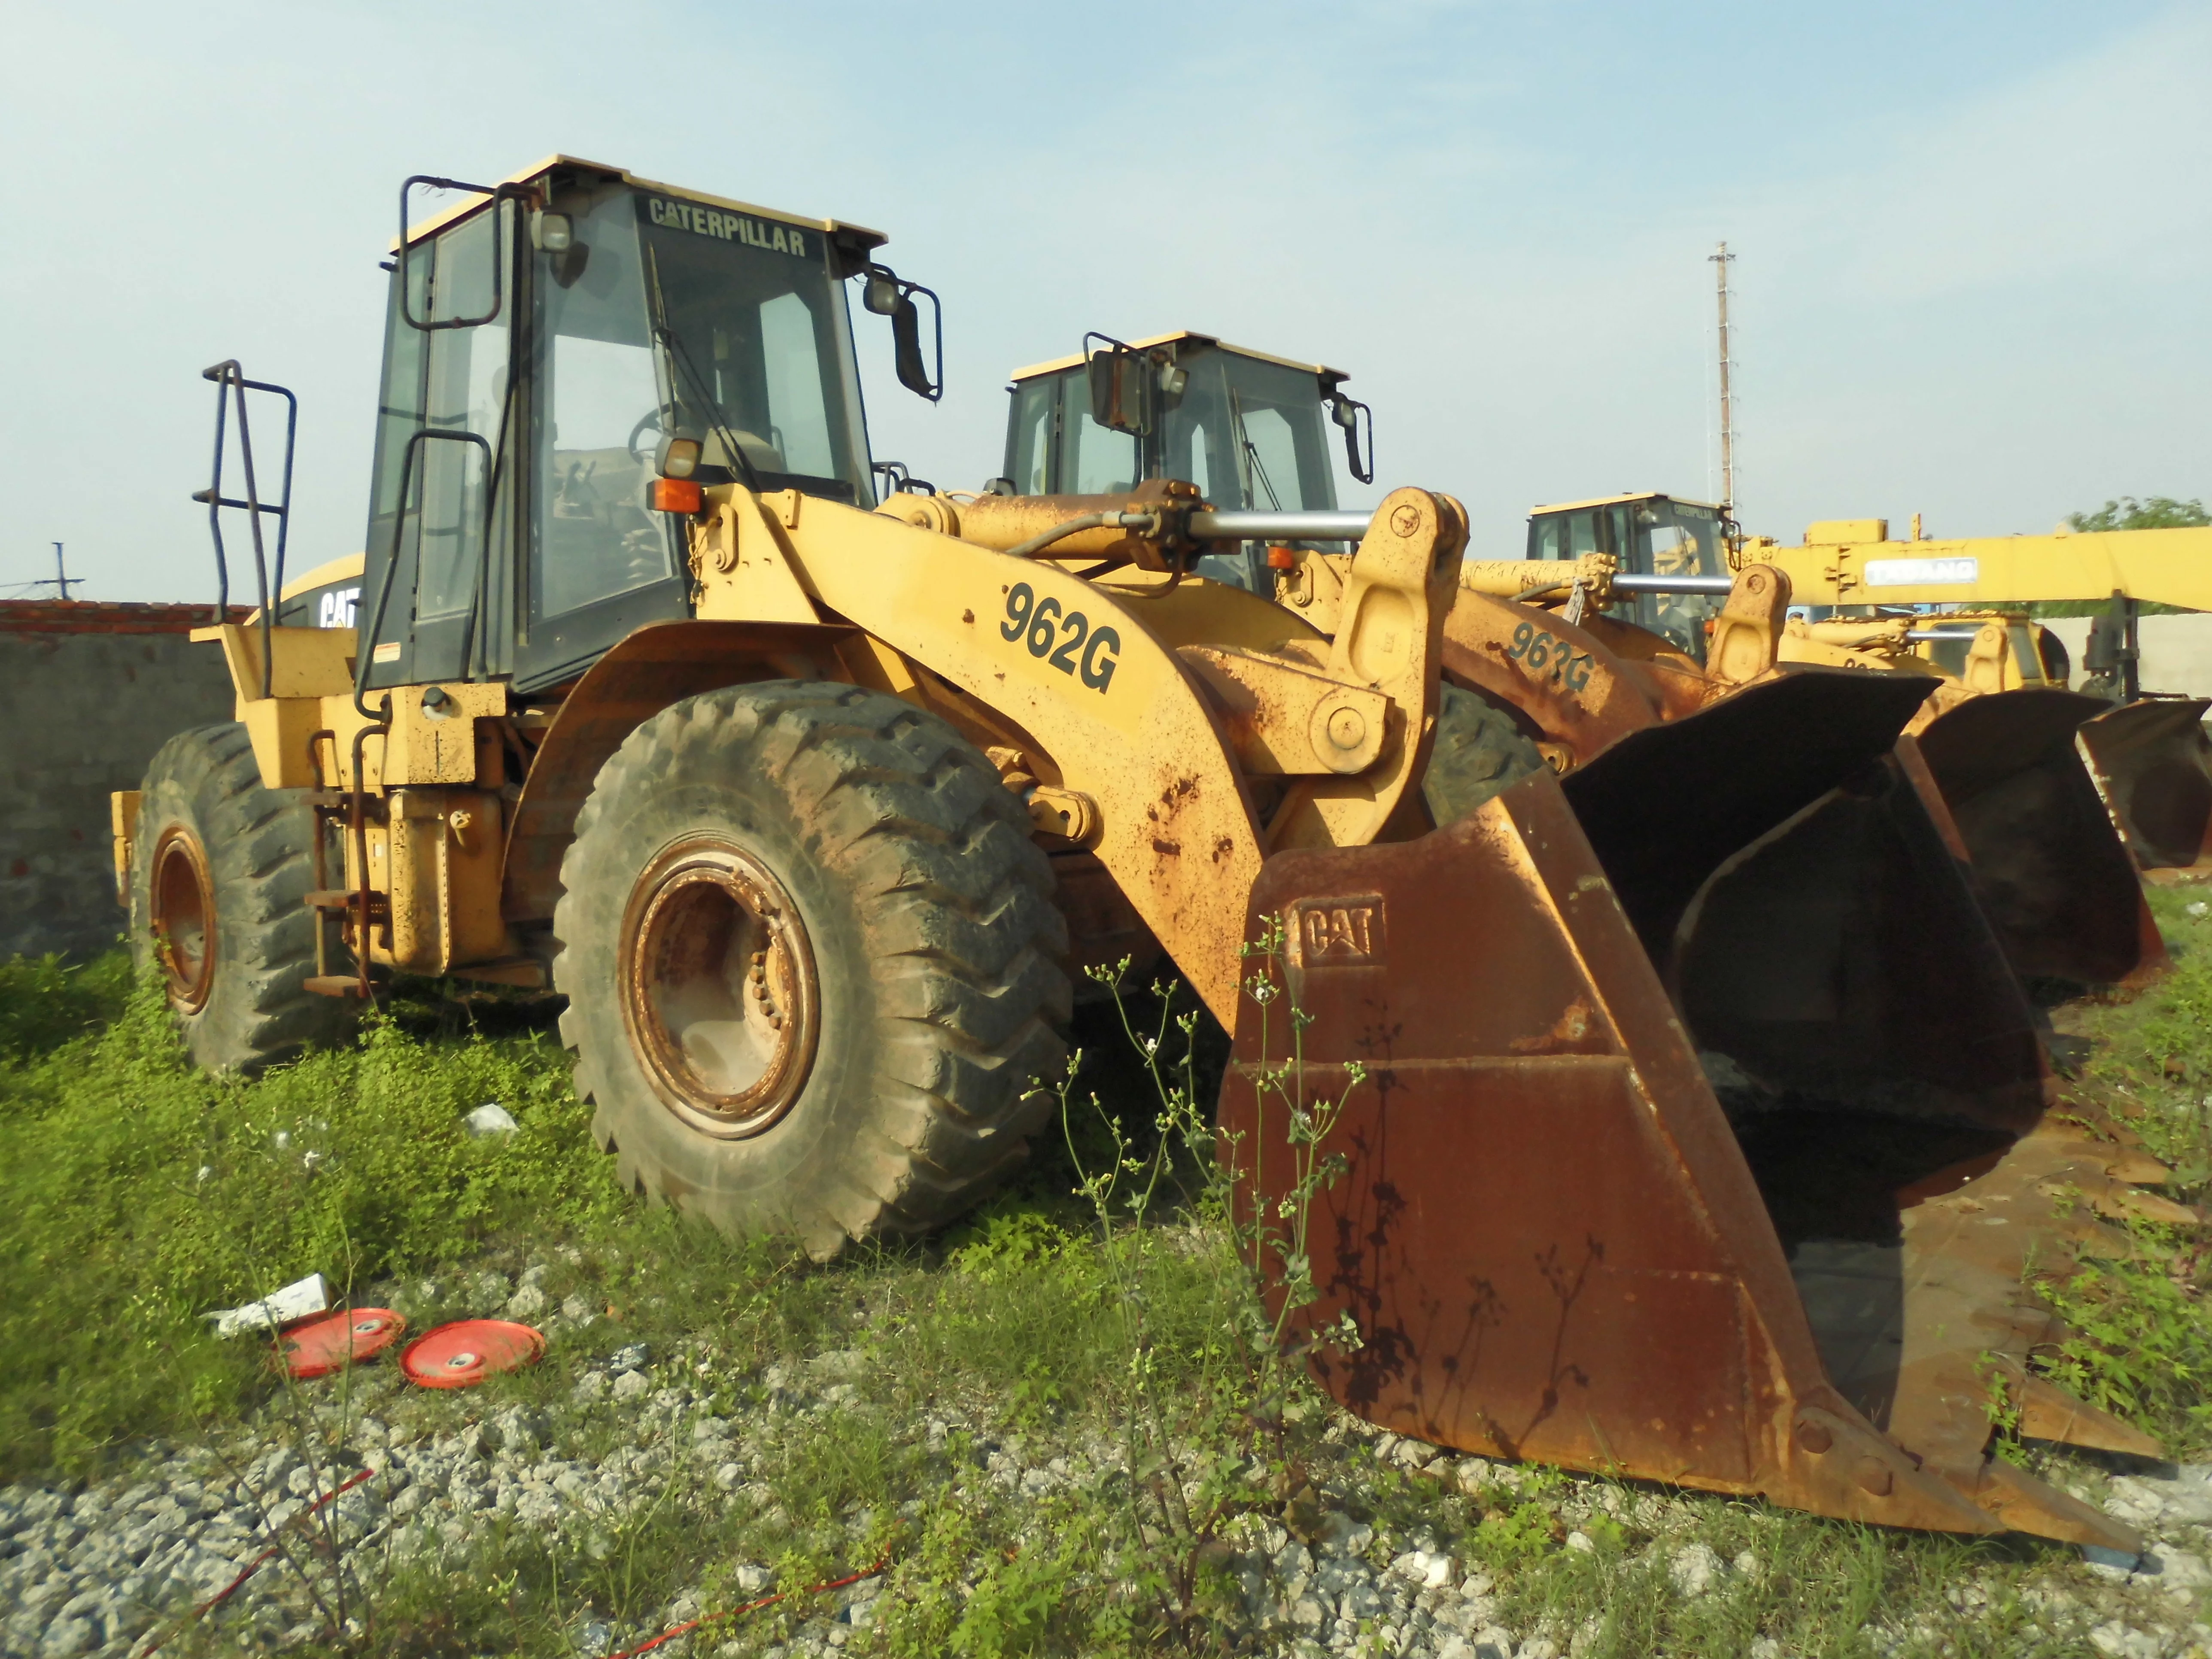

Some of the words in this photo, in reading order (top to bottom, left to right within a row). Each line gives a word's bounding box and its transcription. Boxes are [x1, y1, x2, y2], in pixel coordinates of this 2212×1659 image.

[649, 198, 805, 257] CATERPILLAR
[320, 587, 361, 628] CAT
[1000, 582, 1121, 695] 962G
[1305, 908, 1373, 957] CAT
